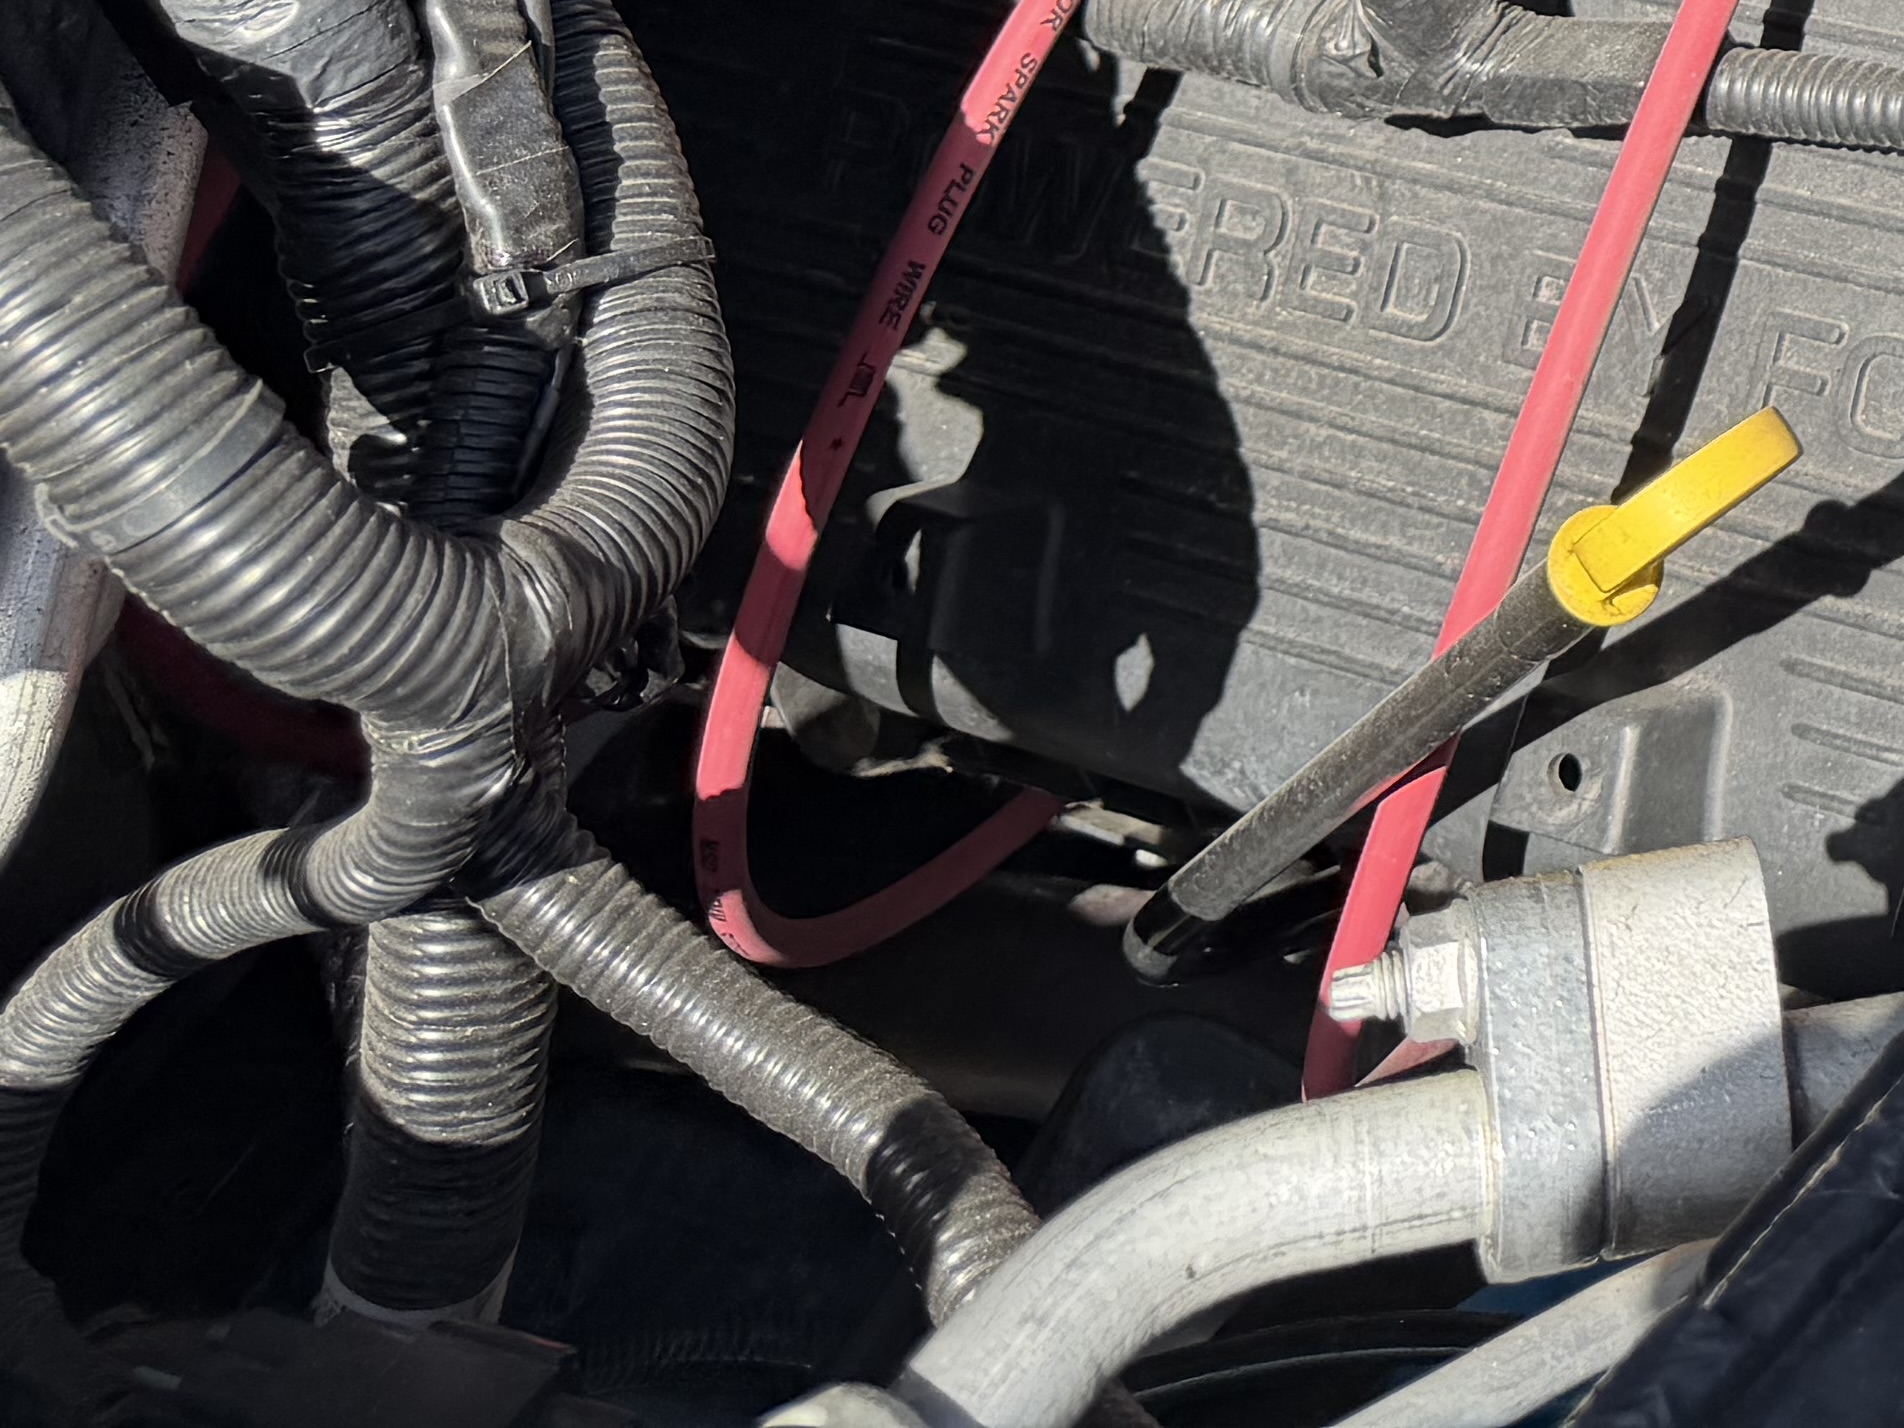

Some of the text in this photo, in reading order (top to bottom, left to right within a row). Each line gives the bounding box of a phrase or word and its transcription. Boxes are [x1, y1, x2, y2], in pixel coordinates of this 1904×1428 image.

[977, 51, 1039, 145] SPARK
[823, 87, 1467, 344] PWERED
[929, 163, 976, 238] PLUG
[878, 260, 926, 332] WIRE
